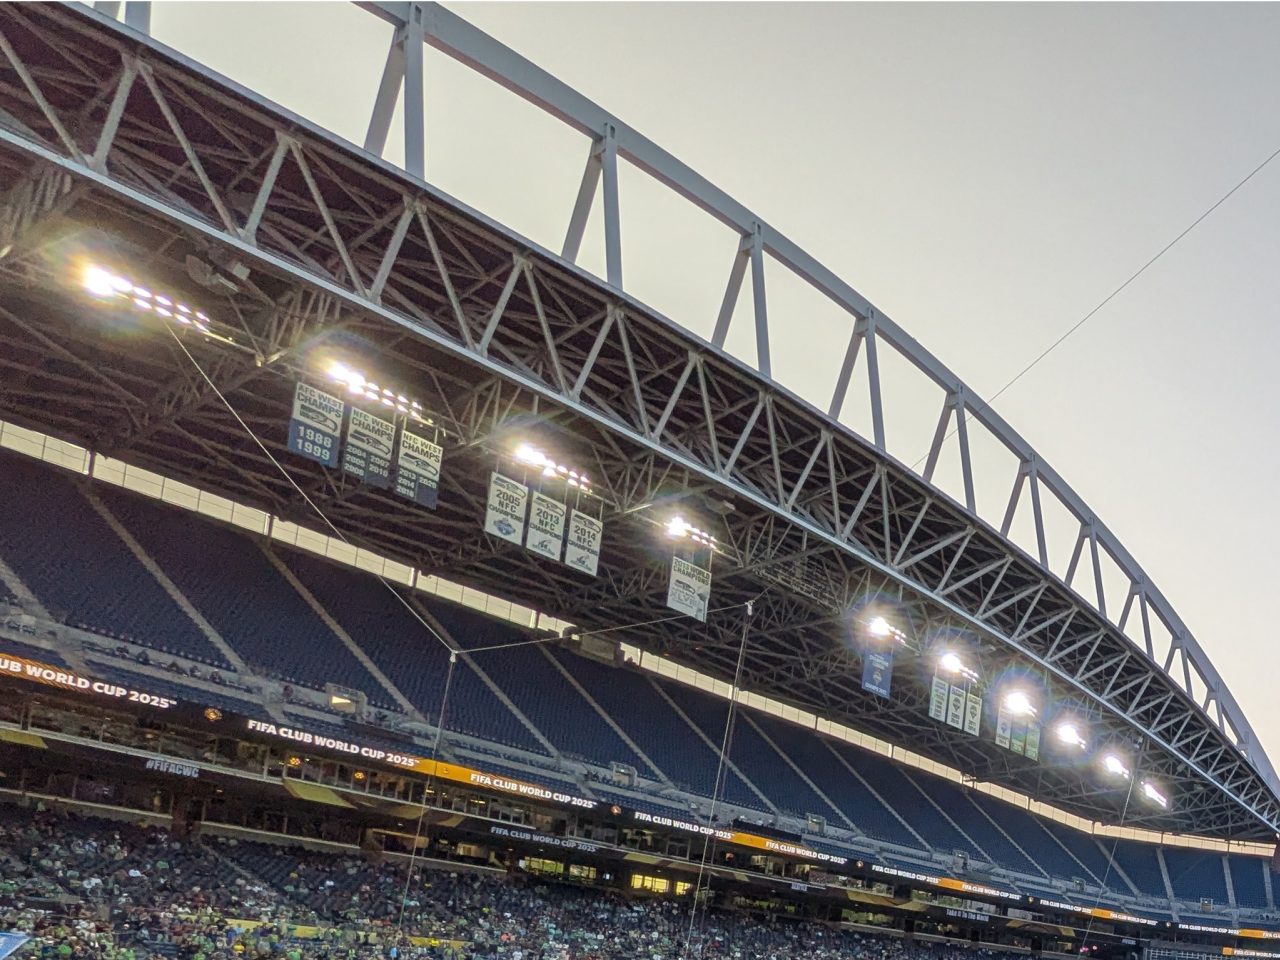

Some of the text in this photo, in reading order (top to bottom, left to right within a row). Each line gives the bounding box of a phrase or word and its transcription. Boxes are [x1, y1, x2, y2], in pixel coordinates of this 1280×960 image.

[297, 393, 341, 418] CHAMPS
[318, 391, 343, 409] WEST
[352, 417, 392, 442] CHAMPS
[353, 409, 395, 433] NFC WEST
[299, 426, 332, 448] 1988
[403, 433, 442, 455] NFC WEST
[296, 439, 330, 460] 1999
[402, 440, 440, 463] CHAMPS
[496, 489, 520, 507] 2005
[498, 500, 517, 513] NFC
[536, 507, 560, 525] 2013
[539, 518, 555, 531] NFC
[574, 525, 596, 541] 2014
[577, 535, 592, 547] NFC
[690, 565, 710, 580] WORLD
[26, 664, 90, 689] WORLD
[93, 682, 127, 697] CUP
[248, 719, 277, 736] FIFA
[279, 727, 313, 743] CLUB
[314, 734, 359, 754] WORLD
[361, 747, 385, 760] CUP
[146, 759, 199, 778] #FIFACWC
[471, 773, 491, 786] FIFA
[493, 778, 517, 791] CLUB
[519, 784, 552, 799] WORLD
[553, 792, 571, 804] CUP
[634, 812, 652, 822] FIFA
[652, 816, 672, 827] CLUB
[672, 819, 699, 833] WORLD
[700, 826, 714, 836] CUP
[491, 826, 509, 837] FIFA
[510, 829, 531, 841] CLUB
[532, 833, 560, 846] WORLD
[765, 841, 779, 850] FIFA
[780, 844, 795, 854] CLUB
[796, 847, 817, 858] WORLD
[818, 852, 830, 861] CUP
